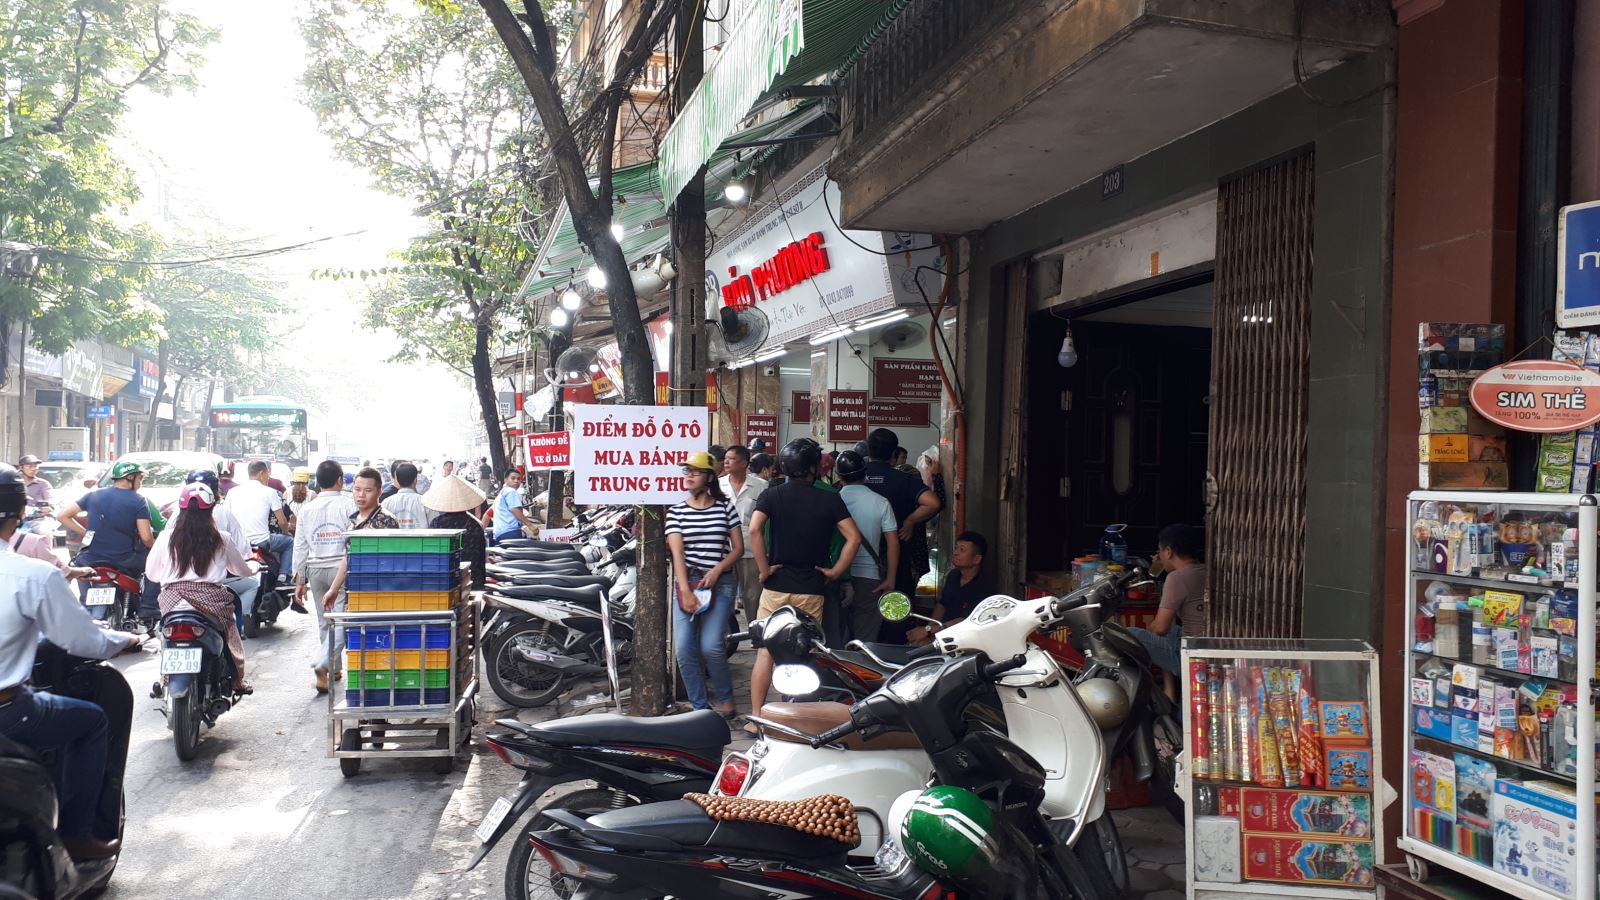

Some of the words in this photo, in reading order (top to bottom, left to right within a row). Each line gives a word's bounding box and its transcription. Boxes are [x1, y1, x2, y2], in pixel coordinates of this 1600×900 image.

[1104, 171, 1120, 194] 203
[766, 218, 779, 233] TRUNG
[1518, 373, 1583, 382] Vietnamobile
[1496, 391, 1536, 408] SIM
[1542, 386, 1587, 410] THẺ
[1514, 411, 1541, 420] 100%
[582, 414, 627, 438] ĐIỂM
[631, 416, 657, 438] ĐỖ
[661, 419, 673, 438] Ô
[678, 419, 702, 438] TÔ
[530, 436, 556, 447] KHÔNG
[557, 433, 568, 445] ĐỂ
[534, 455, 544, 464] XE
[545, 452, 552, 463] Ở
[552, 452, 568, 463] ĐÂY
[594, 450, 636, 465] MUA
[639, 445, 689, 466] BÁNH
[588, 476, 651, 492] TRUNG
[164, 661, 199, 672] 452.09
[916, 841, 948, 870] Grab
